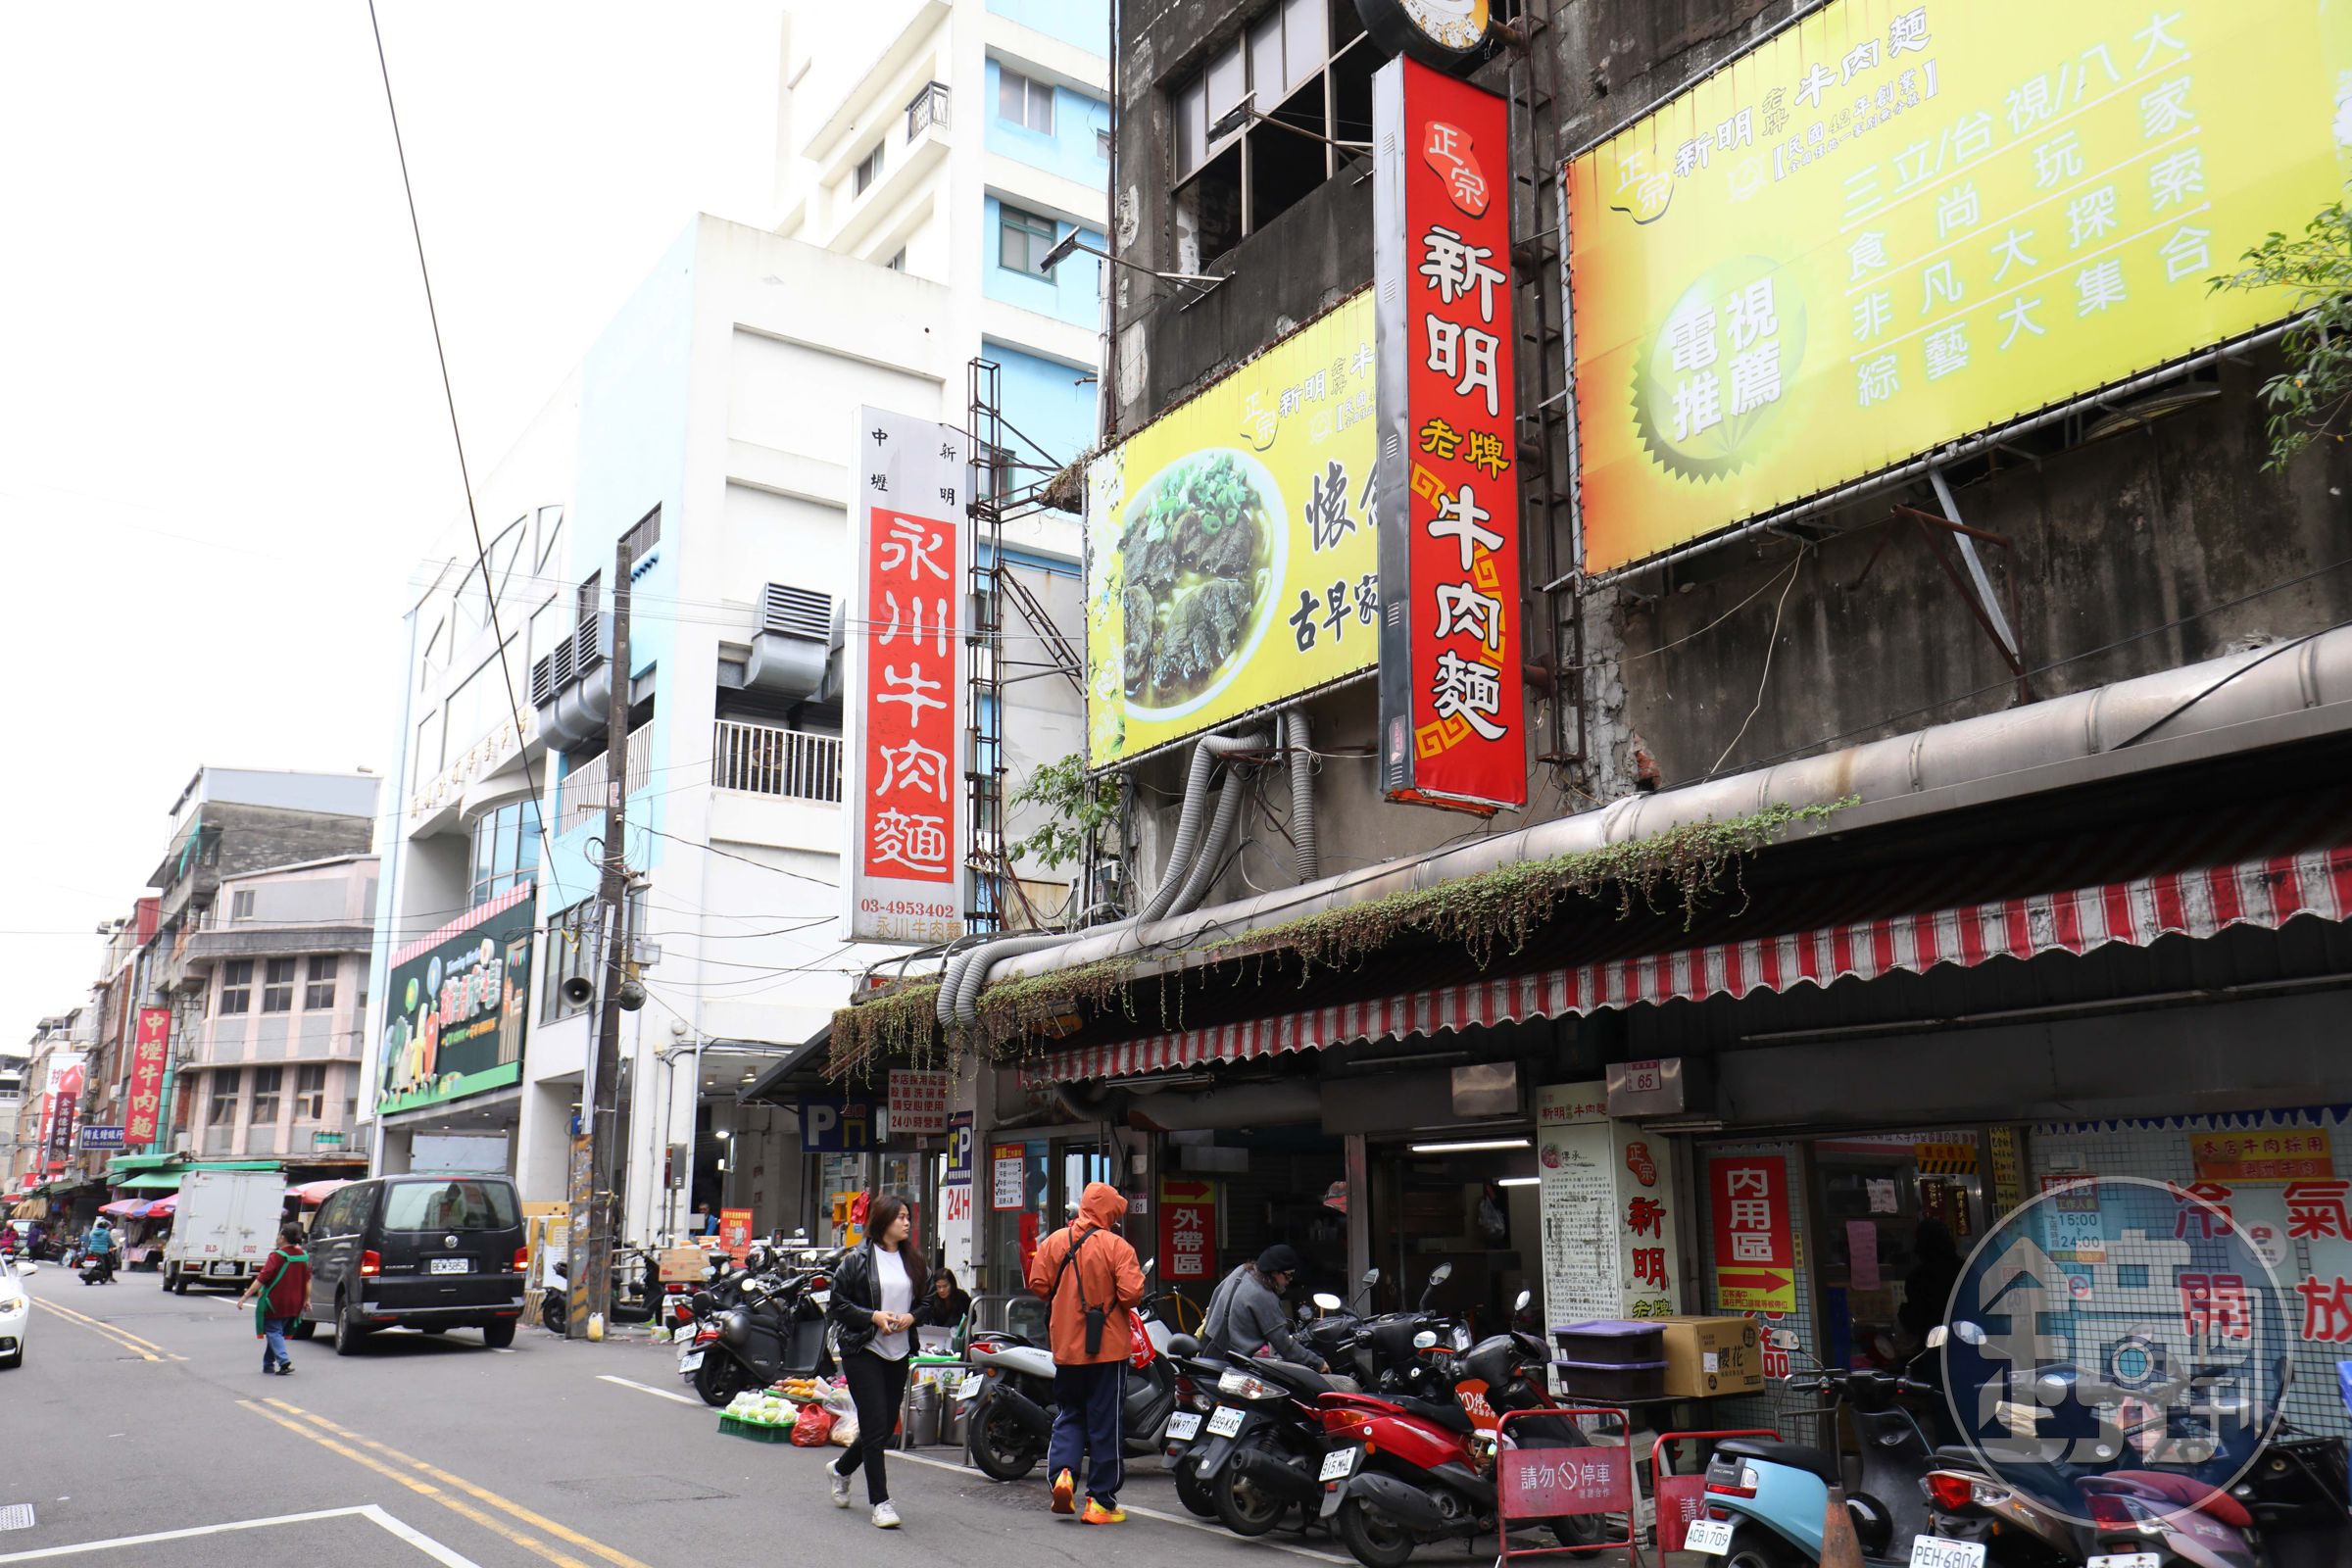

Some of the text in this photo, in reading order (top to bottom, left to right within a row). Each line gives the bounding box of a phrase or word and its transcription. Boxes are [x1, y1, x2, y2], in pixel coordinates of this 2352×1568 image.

[1674, 105, 1754, 177] 新明
[1794, 6, 1932, 108] 牛肉麵
[1429, 123, 1484, 207] 正宗
[1846, 73, 2196, 282] 食尚玩家
[1853, 150, 2206, 343] 非凡大探索
[1419, 224, 1506, 416] 新明
[1669, 275, 1779, 373] 電視
[1857, 224, 2213, 408] 綜藝大集合
[1279, 368, 1326, 418] 新明
[1672, 340, 1783, 443] 推薦
[870, 428, 888, 492] 中壢
[939, 443, 956, 507] 新明
[1419, 418, 1511, 480] 老牌
[1428, 484, 1509, 741] 牛肉麵
[872, 516, 950, 873] 永川牛肉麵
[860, 899, 955, 919] 03-4953402
[876, 916, 962, 941] 永川牛肉麵
[129, 1012, 166, 1140] 中壢牛肉麵
[1638, 1074, 1652, 1089] 65
[958, 1126, 971, 1167] P
[1629, 1145, 1654, 1180] 正宗
[2204, 1137, 2324, 1154] 本店牛肉採用
[948, 1188, 970, 1221] 24H
[1727, 1168, 1773, 1261] 內用區
[2059, 1214, 2097, 1226] 15:00
[1172, 1208, 1204, 1275] 外帶區
[1628, 1197, 1666, 1291] 新明
[2061, 1236, 2100, 1248] 24:00
[1718, 1346, 1743, 1369] 櫻花
[1521, 1463, 1610, 1490] 請勿 停車
